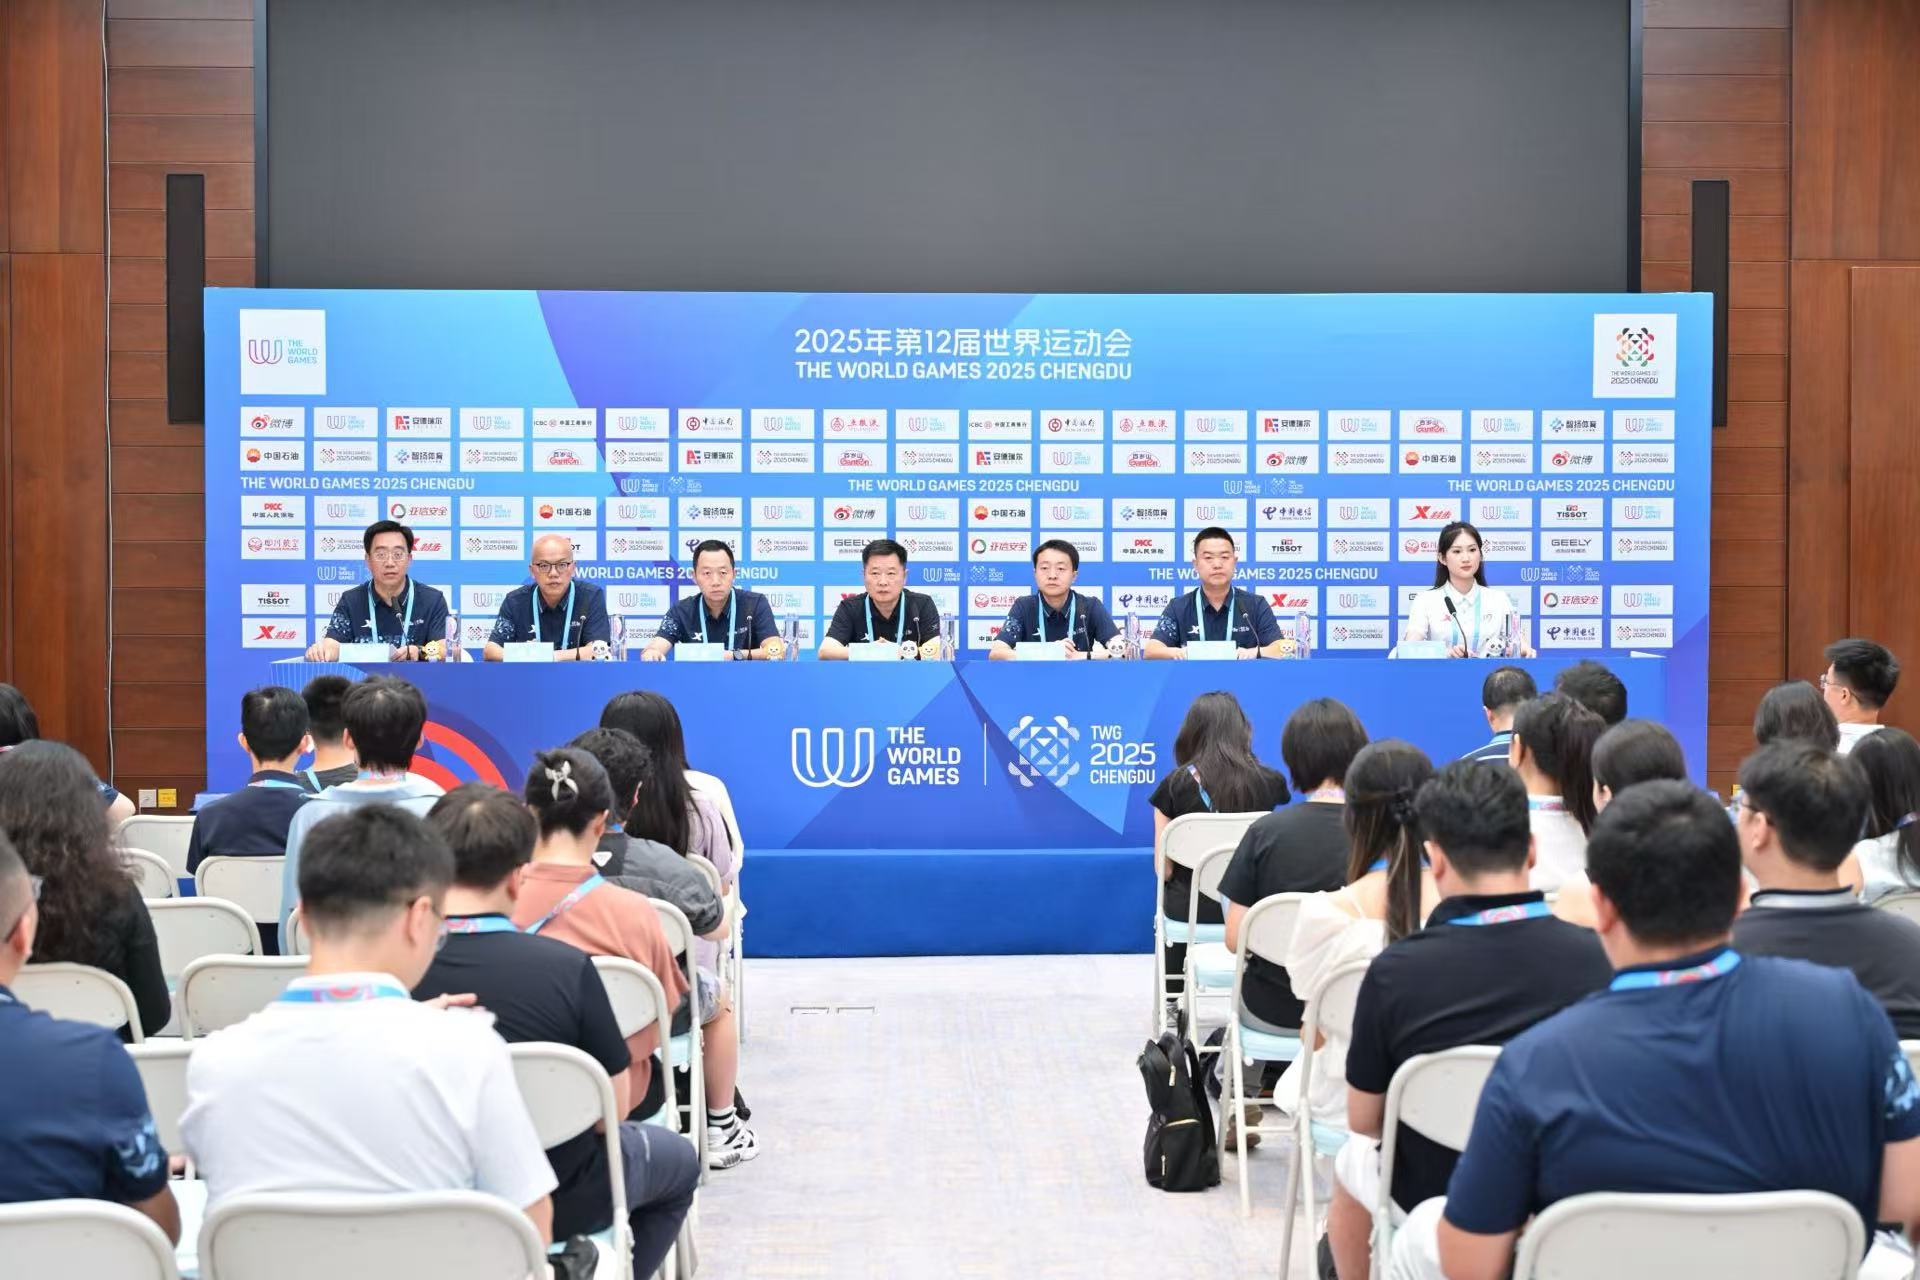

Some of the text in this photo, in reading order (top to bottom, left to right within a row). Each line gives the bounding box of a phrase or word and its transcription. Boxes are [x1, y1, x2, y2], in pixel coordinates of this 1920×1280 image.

[794, 328, 1132, 356] 2025年第12届世界运动会
[796, 362, 1132, 380] THE WORLD GAMES 2025 CHENGDU
[264, 452, 299, 460] 中国石油
[240, 477, 474, 490] THE WORLD GAMES 2025 CHENGDU
[848, 480, 1080, 492] THE WORLD GAMES 2025 CHENGDU
[1448, 480, 1675, 491] THE WORLD GAMES 2025 CHENGDU
[852, 510, 875, 519] 微博
[575, 567, 778, 579] WORLD GAMES 20 ENGDU
[1149, 568, 1173, 580] THE
[1278, 568, 1312, 580] 2025
[1315, 568, 1378, 580] CHENGDU
[887, 726, 926, 744] THE
[1091, 725, 1122, 740] TWG
[887, 747, 961, 765] WORLD
[1090, 743, 1156, 766] 2025
[887, 767, 960, 785] GAMES
[1090, 769, 1155, 784] CHENGDU
